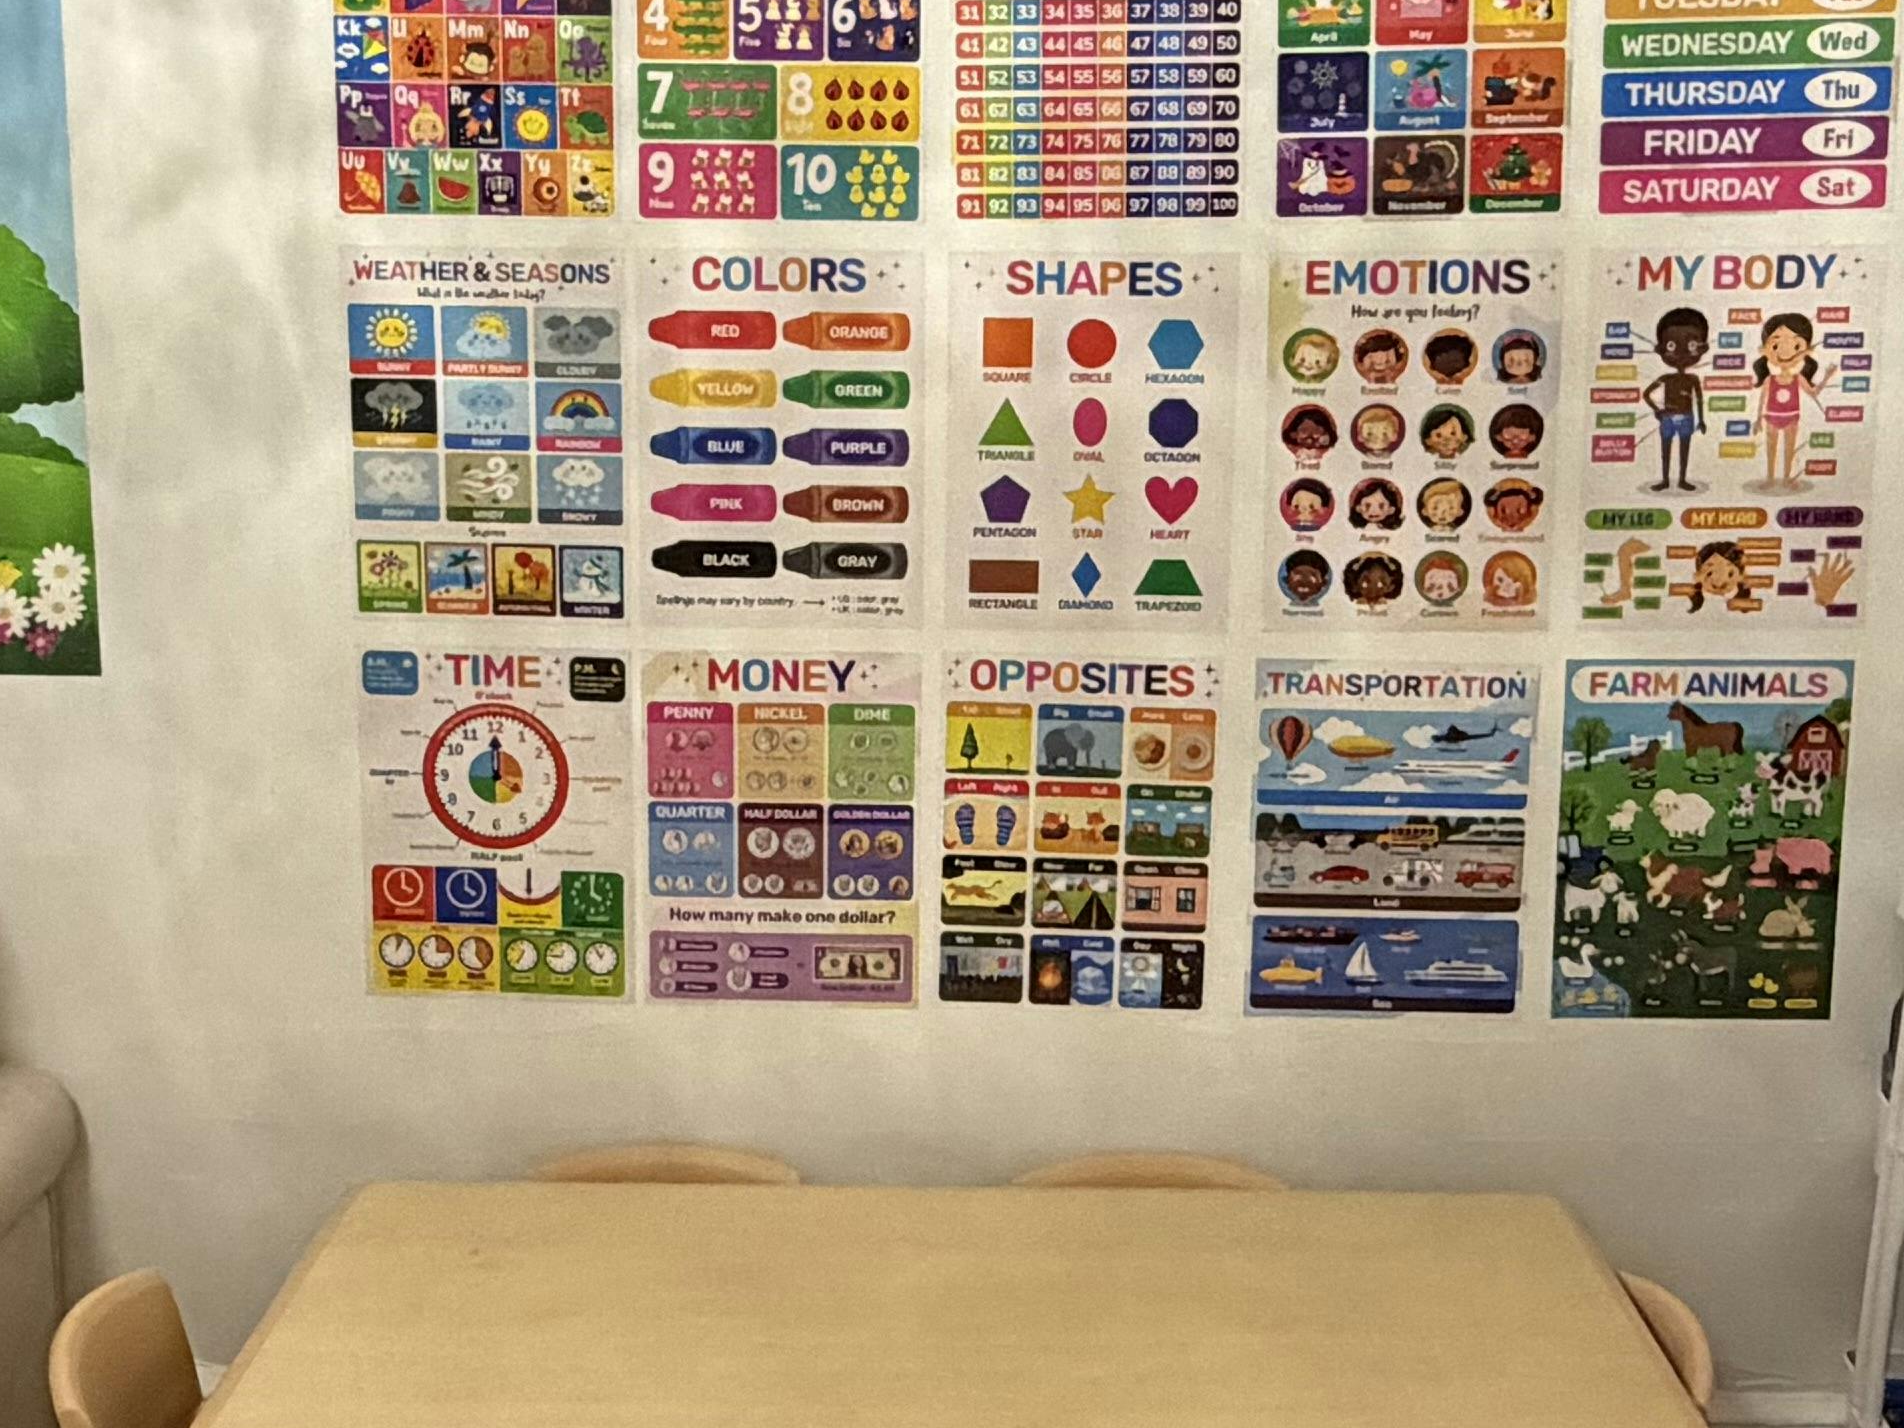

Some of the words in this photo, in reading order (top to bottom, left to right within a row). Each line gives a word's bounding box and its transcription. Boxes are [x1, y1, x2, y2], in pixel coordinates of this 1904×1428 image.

[1310, 31, 1338, 44] April
[1409, 29, 1433, 41] May
[1621, 30, 1794, 57] WEDNESDAY
[1820, 31, 1867, 52] Wed
[646, 70, 674, 114] 7
[786, 72, 814, 116] 8
[1625, 79, 1785, 107] THURSDAY
[1822, 81, 1860, 101] Thu
[1310, 117, 1336, 129] July
[1399, 115, 1440, 128] August
[1485, 112, 1549, 126] September
[1644, 128, 1762, 156] FRIDAY
[1824, 129, 1854, 149] Fri
[647, 150, 674, 194] 9
[786, 152, 837, 196] 10
[1623, 176, 1780, 204] SATURDAY
[1817, 177, 1855, 197] Sat
[1299, 202, 1344, 214] October
[1388, 200, 1447, 212] November
[1485, 198, 1544, 210] December
[353, 260, 468, 281] WEATHER
[473, 264, 491, 282] &
[495, 262, 610, 284] SEASONS
[692, 256, 867, 293] COLORS
[1006, 260, 1183, 297] SHAPES
[1305, 259, 1531, 295] EMOTIONS
[1638, 255, 1705, 291] MY
[1713, 254, 1838, 291] BODY
[1351, 304, 1379, 318] How
[1382, 307, 1401, 318] are
[1405, 307, 1428, 323] you
[1432, 304, 1480, 322] feeling?
[711, 325, 740, 338] RED
[830, 325, 888, 339] ORANGE
[982, 372, 1032, 383] SQUARE
[1069, 373, 1112, 384] CIRCLE
[1145, 373, 1205, 384] HEXAGON
[696, 383, 754, 396] YELLOW
[835, 384, 883, 397] GREEN
[707, 440, 745, 453] BLUE
[831, 442, 886, 455] PURPLE
[978, 450, 1035, 462] TRIANGLE
[1144, 452, 1201, 463] OCTAGON
[709, 497, 743, 510] PINK
[833, 499, 884, 512] BROWN
[1602, 513, 1625, 527] MY
[1629, 513, 1654, 527] LEG
[1691, 512, 1716, 525] MY
[973, 527, 1037, 538] PENTAGON
[1072, 528, 1103, 539] STAR
[1150, 529, 1191, 540] HEART
[702, 554, 750, 567] BLACK
[838, 555, 878, 568] GRAY
[969, 598, 1038, 610] RECTANGLE
[1058, 599, 1114, 610] DIAMOND
[1135, 601, 1202, 612] TRAPEZOID
[444, 653, 541, 689] TIME
[708, 658, 856, 693] MONEY
[970, 658, 1195, 697] OPPOSITES
[1267, 672, 1527, 699] TRANSPORTATION
[1589, 672, 1680, 697] FARM
[1684, 672, 1829, 698] ANIMALS
[664, 706, 714, 720] PENNY
[754, 707, 808, 720] NICKEL
[854, 708, 891, 722] DIME
[655, 806, 726, 820] QUARTER
[744, 809, 772, 820] HALF
[774, 809, 818, 820] DOLLAR
[669, 907, 706, 921] How
[709, 909, 753, 926] many
[757, 909, 802, 923] make
[805, 911, 835, 923] one
[843, 910, 896, 925] dollar?
